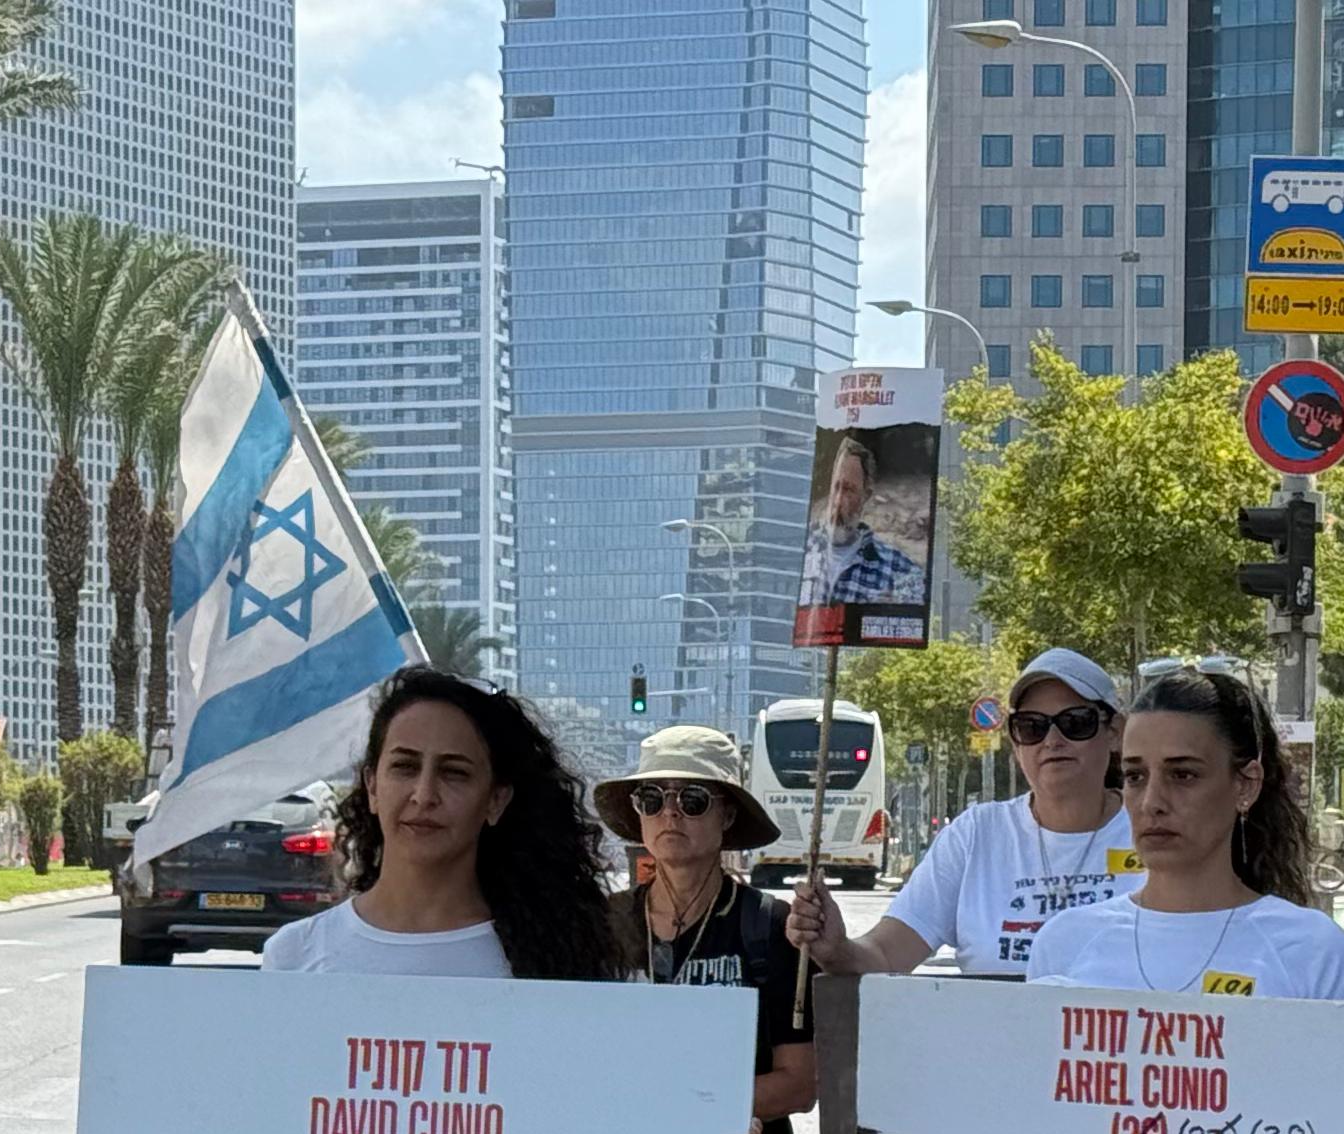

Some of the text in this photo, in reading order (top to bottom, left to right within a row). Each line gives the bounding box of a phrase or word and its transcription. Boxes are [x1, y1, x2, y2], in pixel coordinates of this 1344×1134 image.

[1250, 294, 1290, 316] 14:00
[1062, 1006, 1225, 1059] אריאל קוניו
[347, 1037, 492, 1096] דוד קוניו
[1054, 1059, 1228, 1113] ARIEL CUNIO
